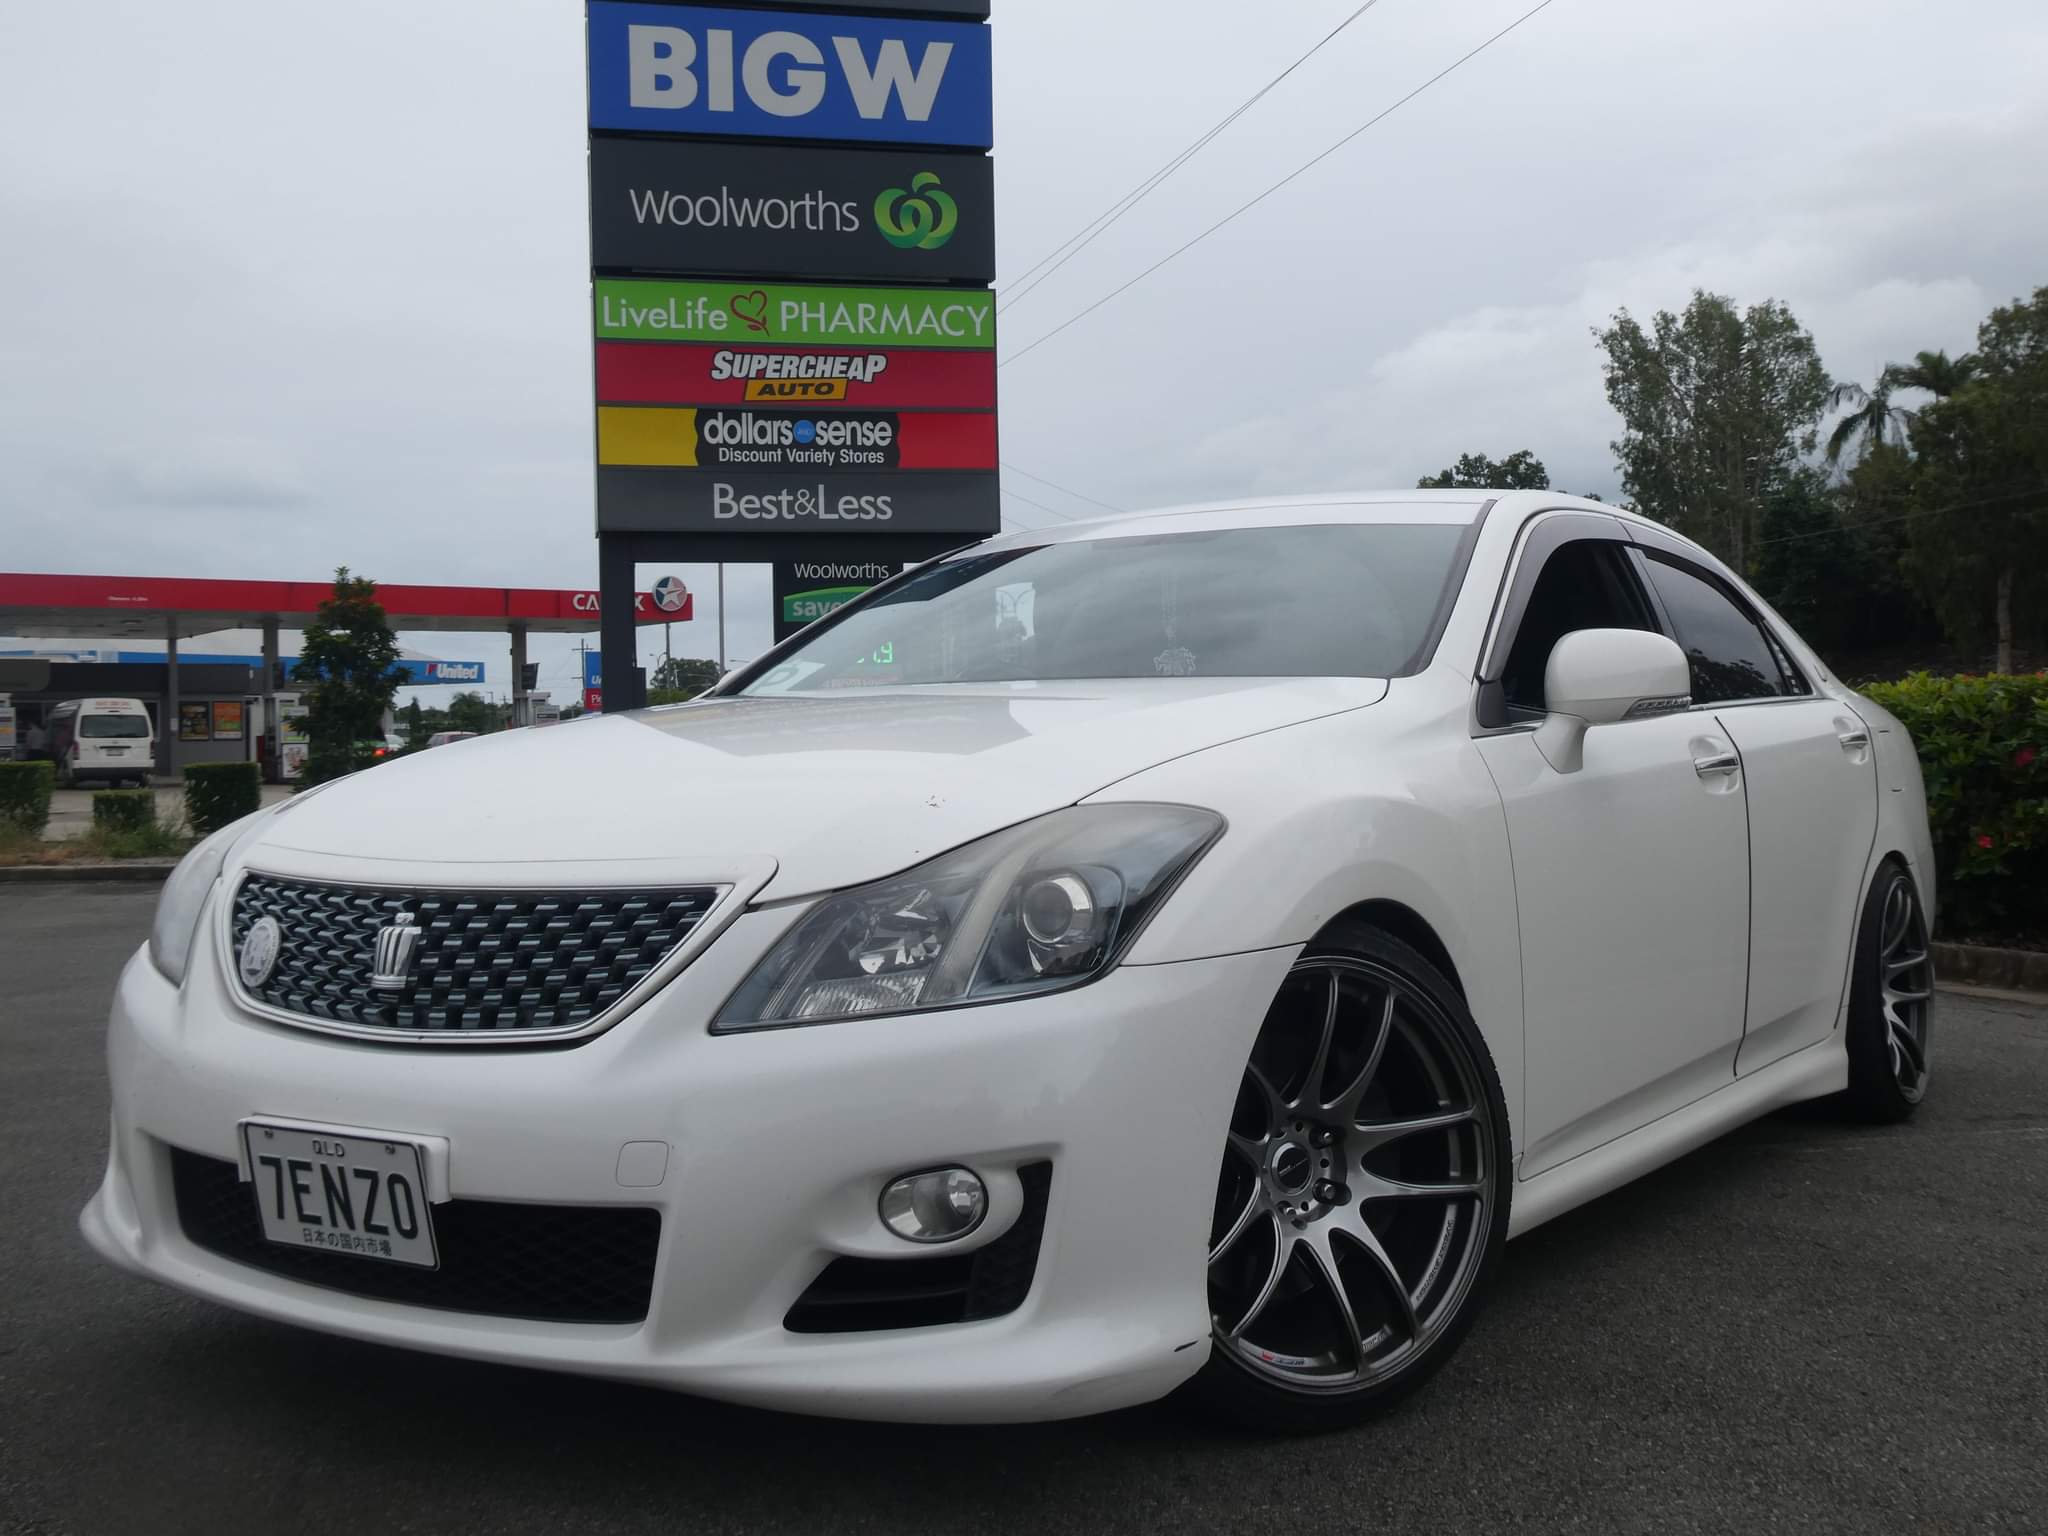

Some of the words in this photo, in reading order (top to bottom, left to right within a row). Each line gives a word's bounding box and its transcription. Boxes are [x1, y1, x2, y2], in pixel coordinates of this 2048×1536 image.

[629, 186, 860, 232] Woolworths
[602, 296, 728, 331] LiveLife
[780, 300, 989, 337] PHARMACY
[757, 382, 835, 396] AUTO
[703, 411, 794, 445] dollars
[815, 420, 893, 447] sense
[718, 447, 783, 463] Discount
[786, 449, 836, 467] Variety
[839, 449, 885, 464] Stores
[794, 562, 890, 579] Woolworths
[436, 662, 479, 680] United
[311, 1140, 346, 1158] QLD
